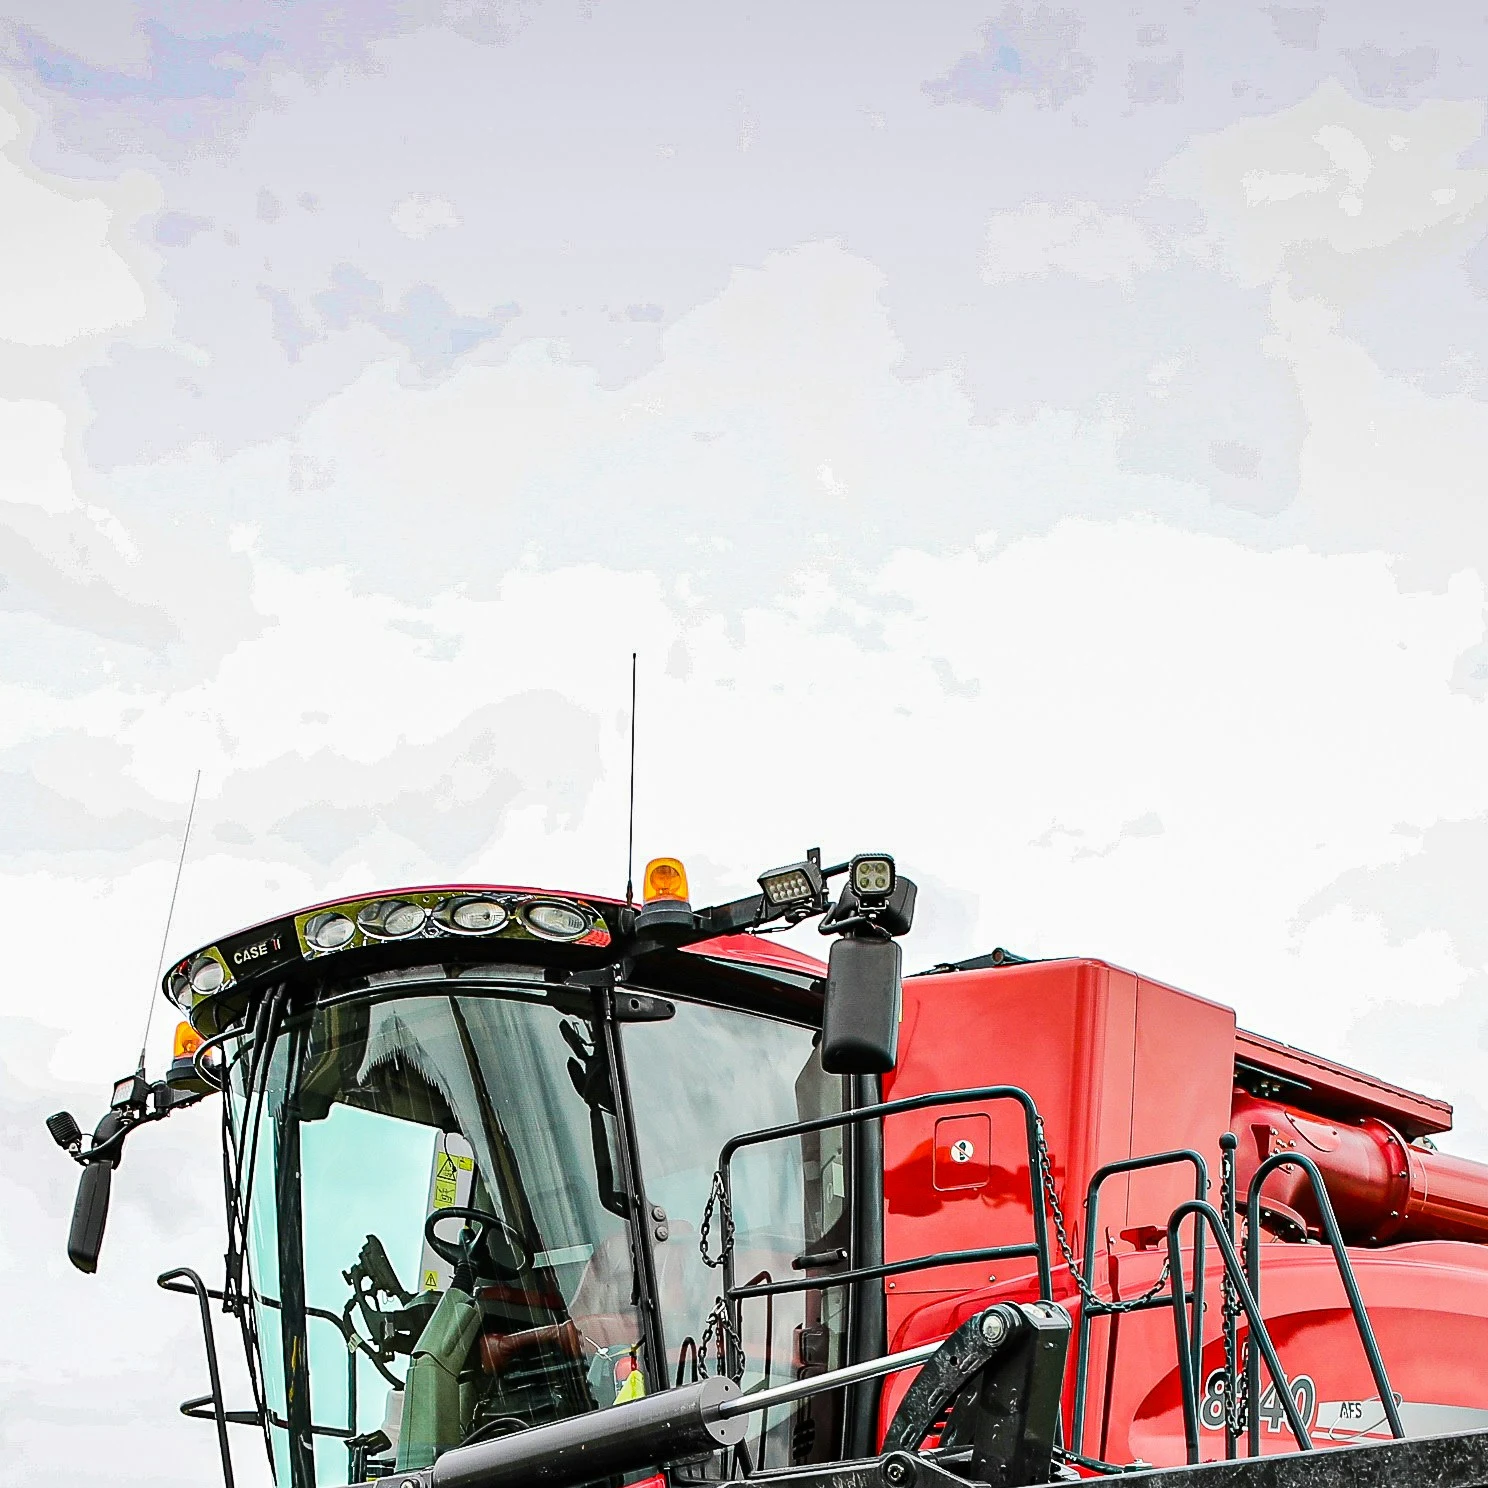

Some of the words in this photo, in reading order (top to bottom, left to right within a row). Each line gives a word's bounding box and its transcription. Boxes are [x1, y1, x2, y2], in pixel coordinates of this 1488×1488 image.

[233, 943, 268, 965] CASE
[1200, 1368, 1315, 1433] 840
[1339, 1402, 1362, 1419] AFS
